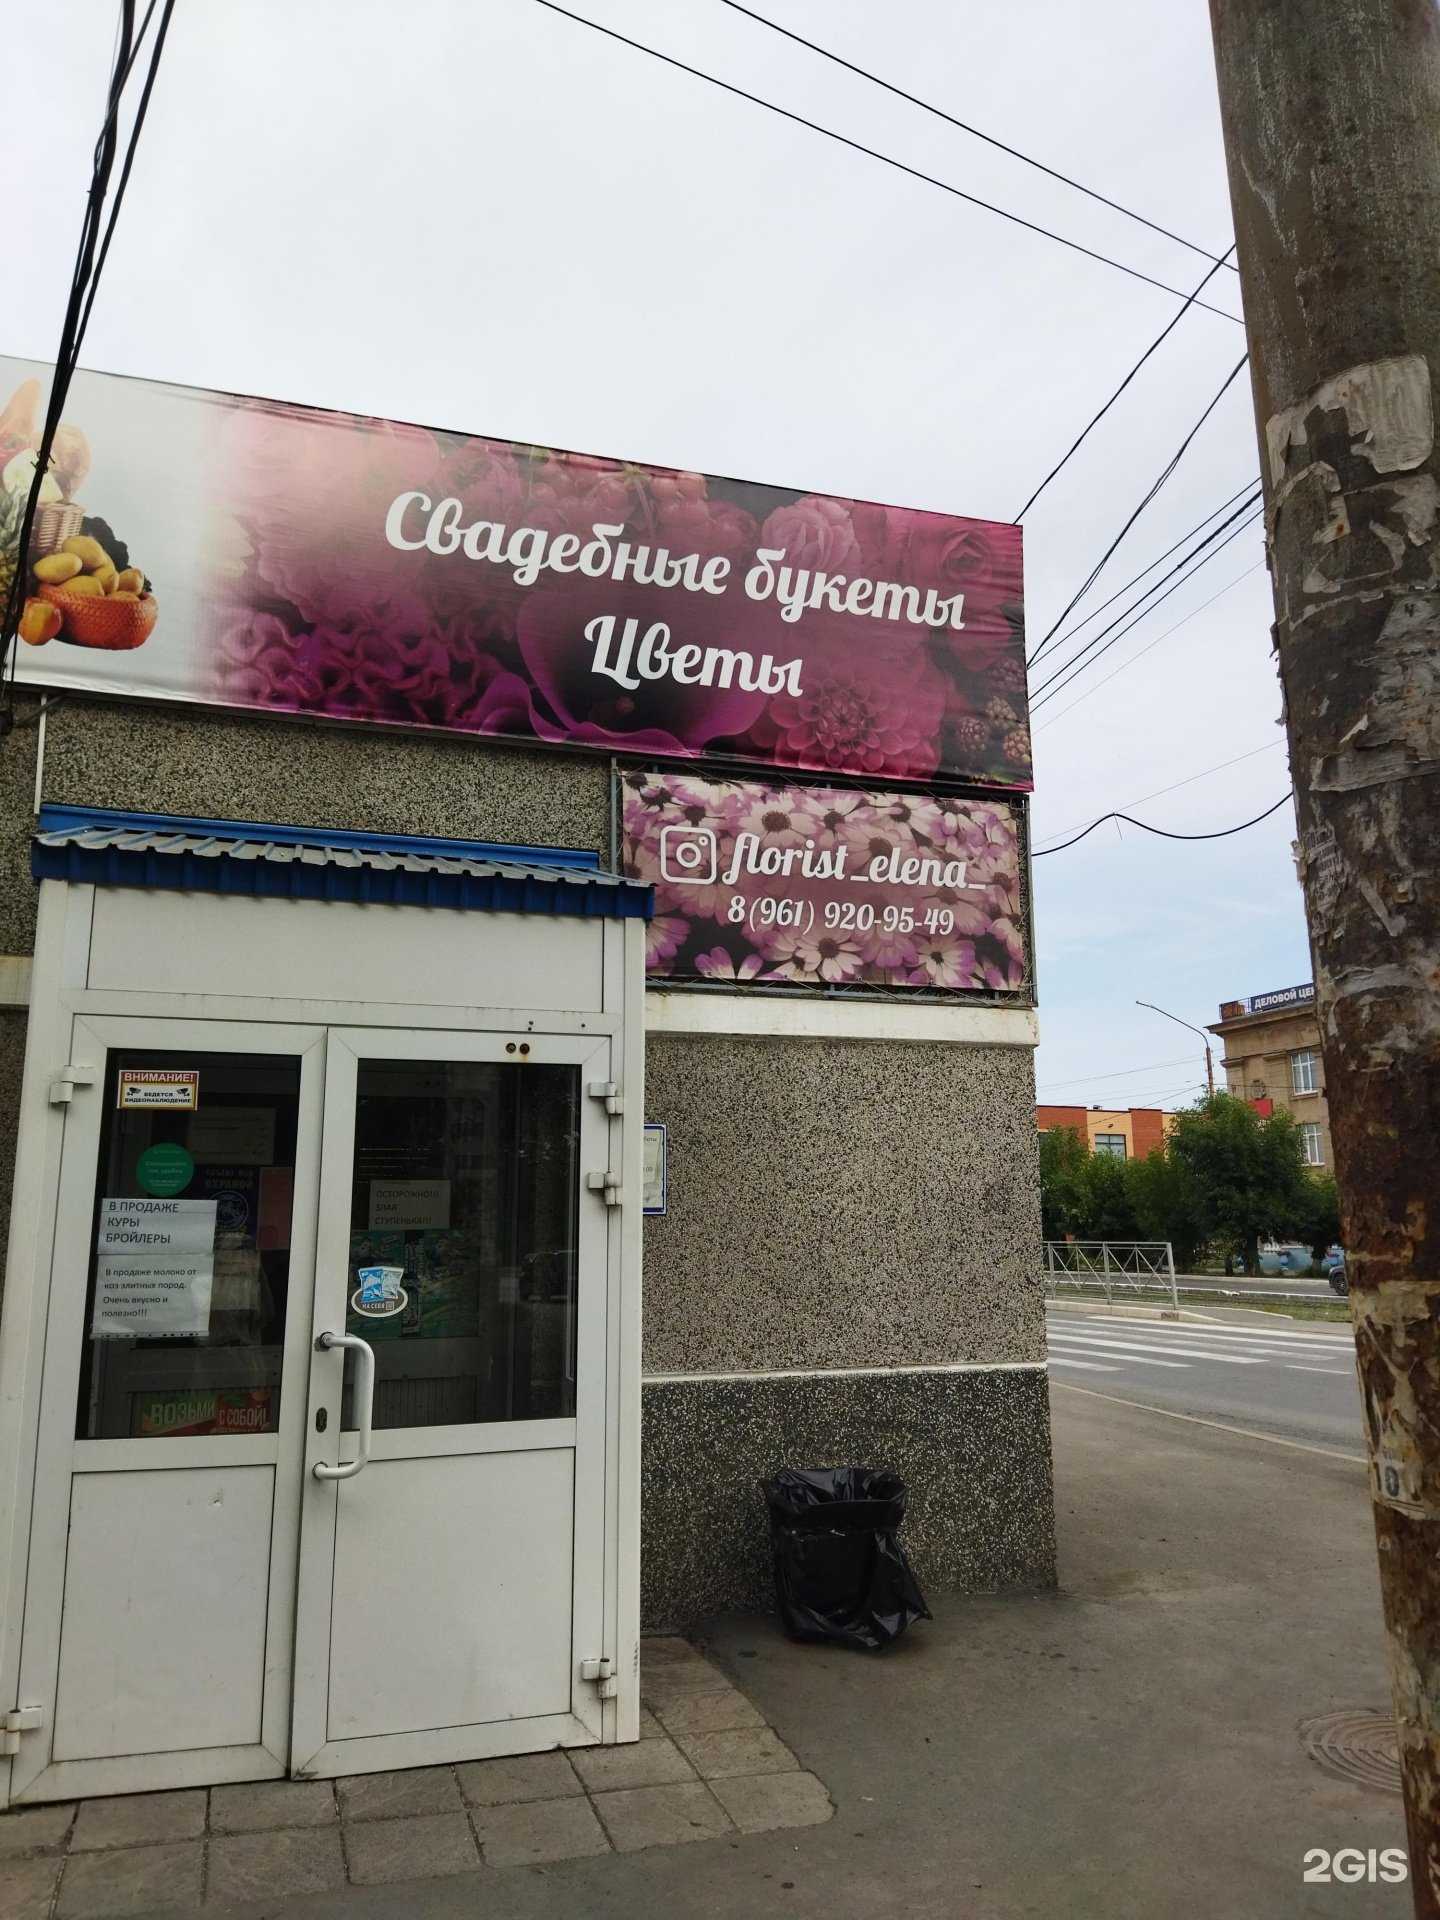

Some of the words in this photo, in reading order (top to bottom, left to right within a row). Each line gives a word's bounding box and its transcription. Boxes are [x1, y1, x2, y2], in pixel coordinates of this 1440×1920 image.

[385, 490, 731, 595] Свадебные
[744, 548, 967, 631] букеты
[583, 615, 804, 697] Цветы
[824, 901, 955, 936] 920-95-49
[1254, 988, 1297, 1009] ДЕЛОВОЙ
[124, 1072, 194, 1083] ВНИМАНИЕ!
[109, 1201, 116, 1211] В
[120, 1201, 180, 1214] ПРОДАЖЕ
[107, 1217, 140, 1228] КУРЫ
[105, 1232, 171, 1244] БРОЙЛЕРЫ
[103, 1296, 130, 1304] Очень
[151, 1400, 217, 1426] ВОЗЬМИ
